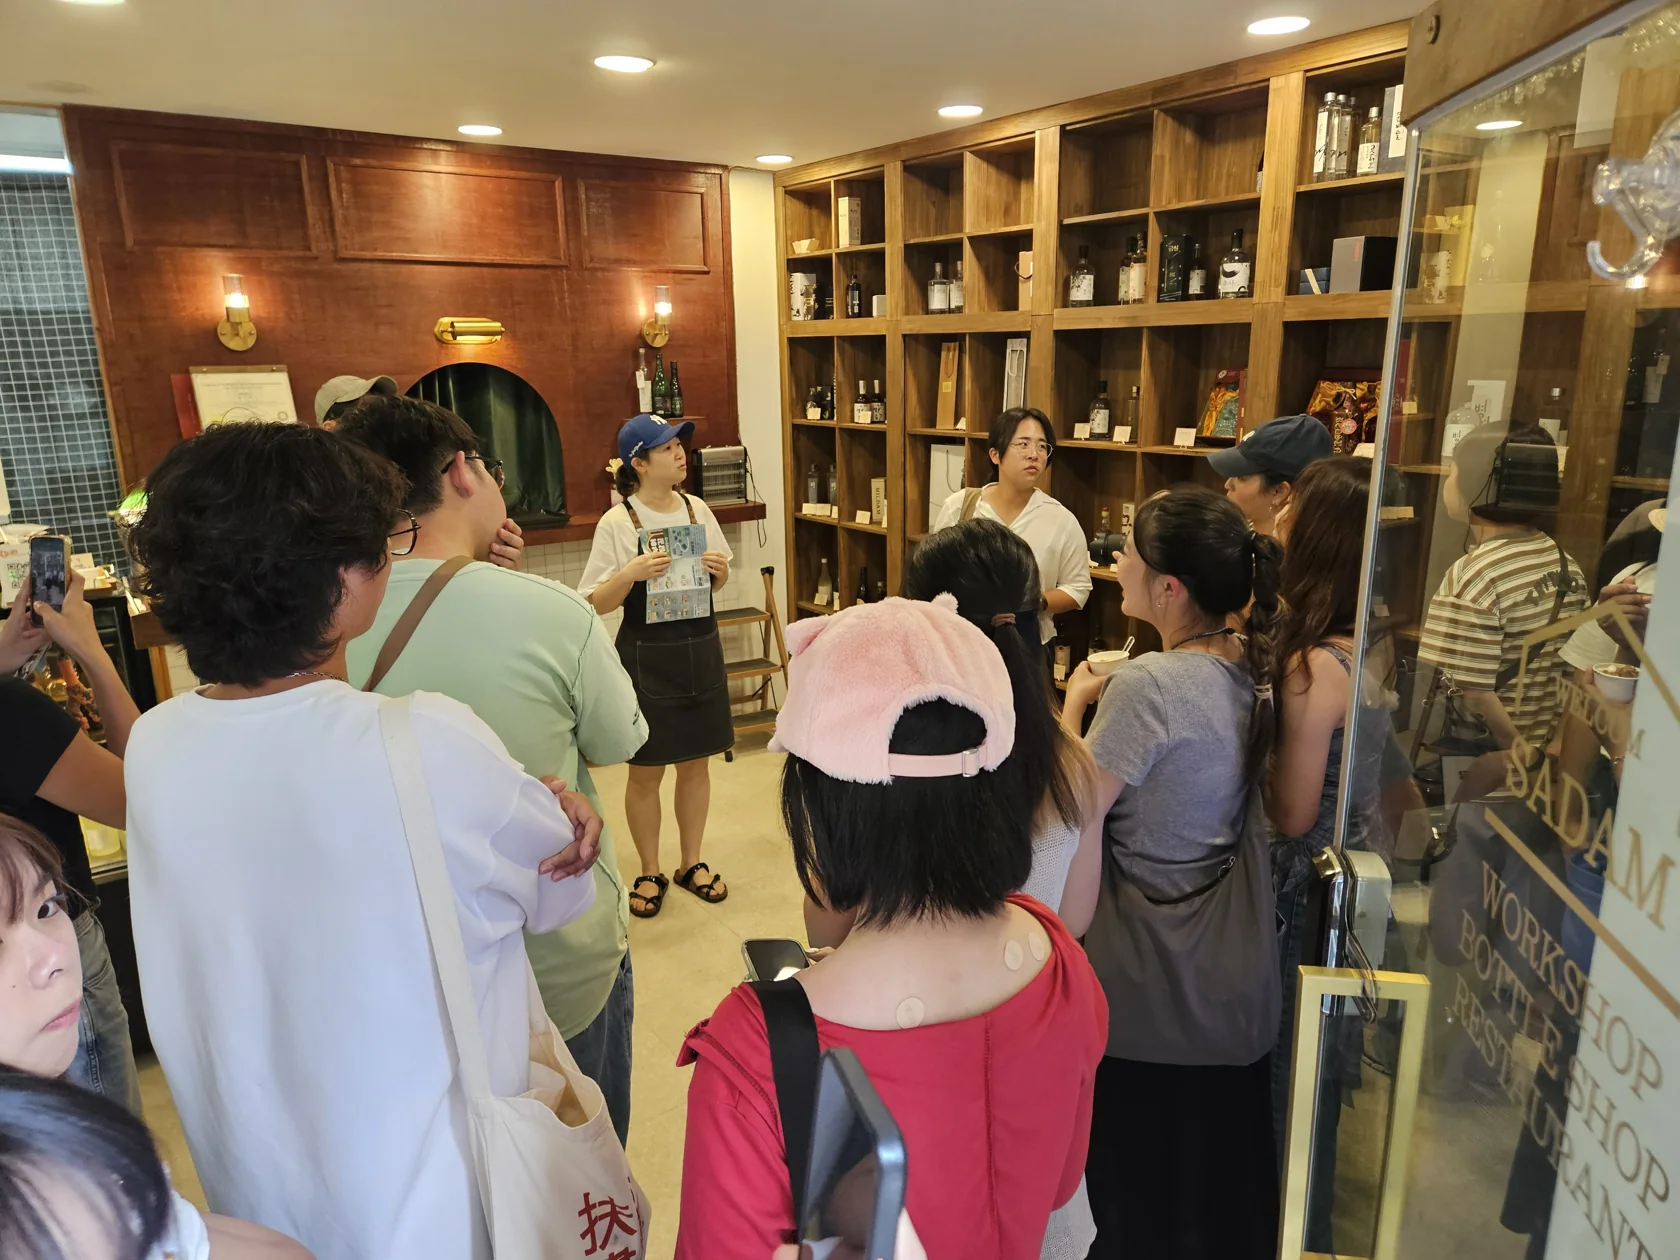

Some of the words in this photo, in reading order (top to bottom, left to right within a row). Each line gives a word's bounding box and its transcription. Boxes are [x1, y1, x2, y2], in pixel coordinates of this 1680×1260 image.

[1506, 735, 1676, 931] SADAM
[1459, 908, 1563, 1081] BOTTLE
[1563, 1054, 1670, 1212] SHOP
[1482, 860, 1664, 1102] WORKSHOP
[577, 1191, 638, 1260] 扶
